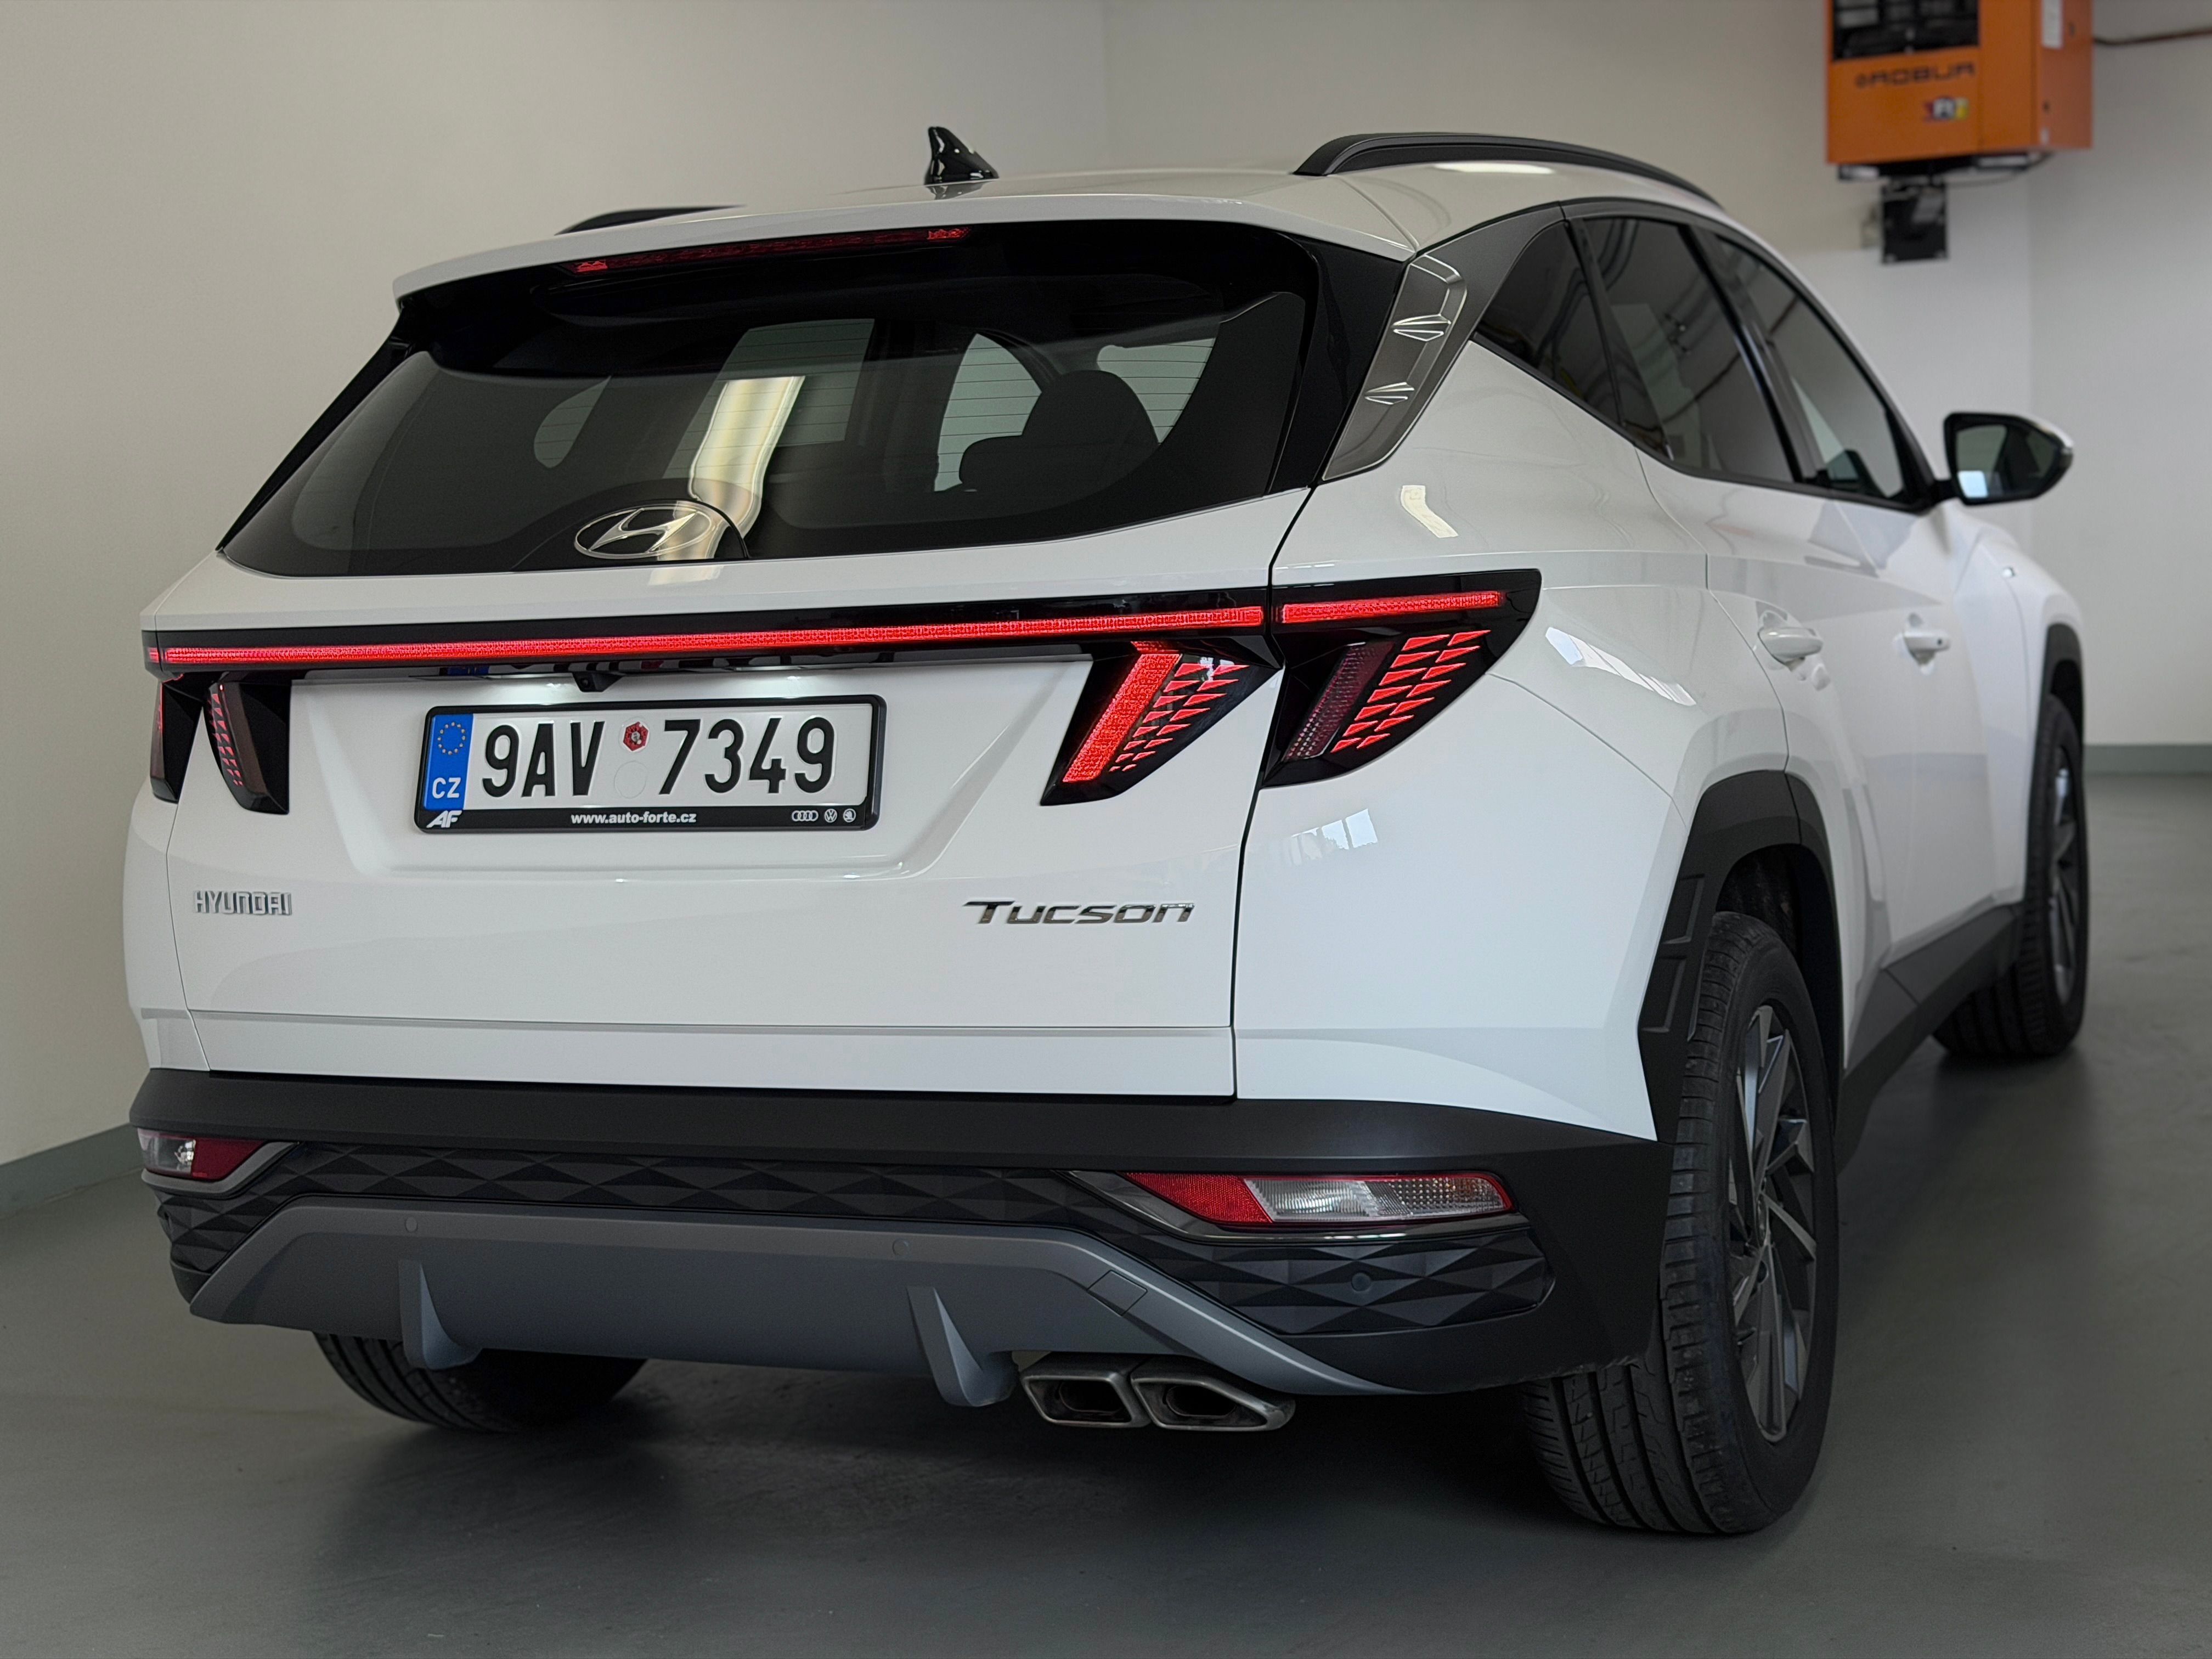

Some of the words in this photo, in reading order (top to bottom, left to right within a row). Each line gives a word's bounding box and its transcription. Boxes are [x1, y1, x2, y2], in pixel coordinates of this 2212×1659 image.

[482, 720, 605, 798] 9AV
[658, 716, 835, 795] 7349
[432, 777, 461, 799] CZ
[426, 810, 462, 828] AF
[571, 811, 697, 823] www.auto-forte.cz
[194, 890, 292, 916] HYUNDAI
